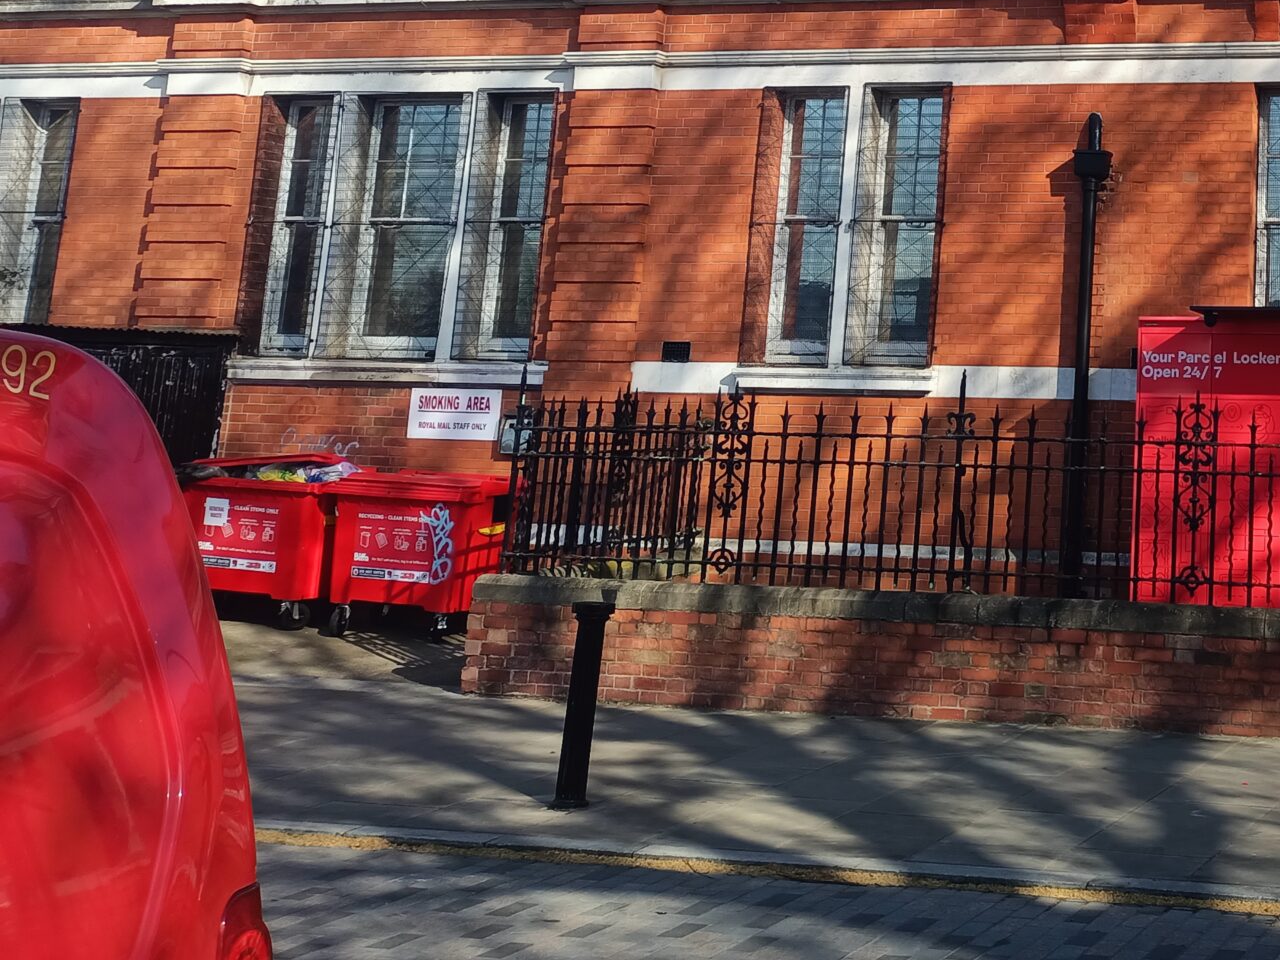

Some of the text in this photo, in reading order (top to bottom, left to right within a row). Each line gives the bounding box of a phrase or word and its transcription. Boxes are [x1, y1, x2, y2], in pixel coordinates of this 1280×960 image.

[1142, 350, 1175, 364] Your
[1, 344, 56, 400] 92
[1141, 365, 1180, 381] Open
[418, 395, 491, 411] SMOKING AREA
[418, 421, 436, 429] ROYAL
[437, 422, 451, 430] MAIL
[452, 422, 471, 431] STAFF
